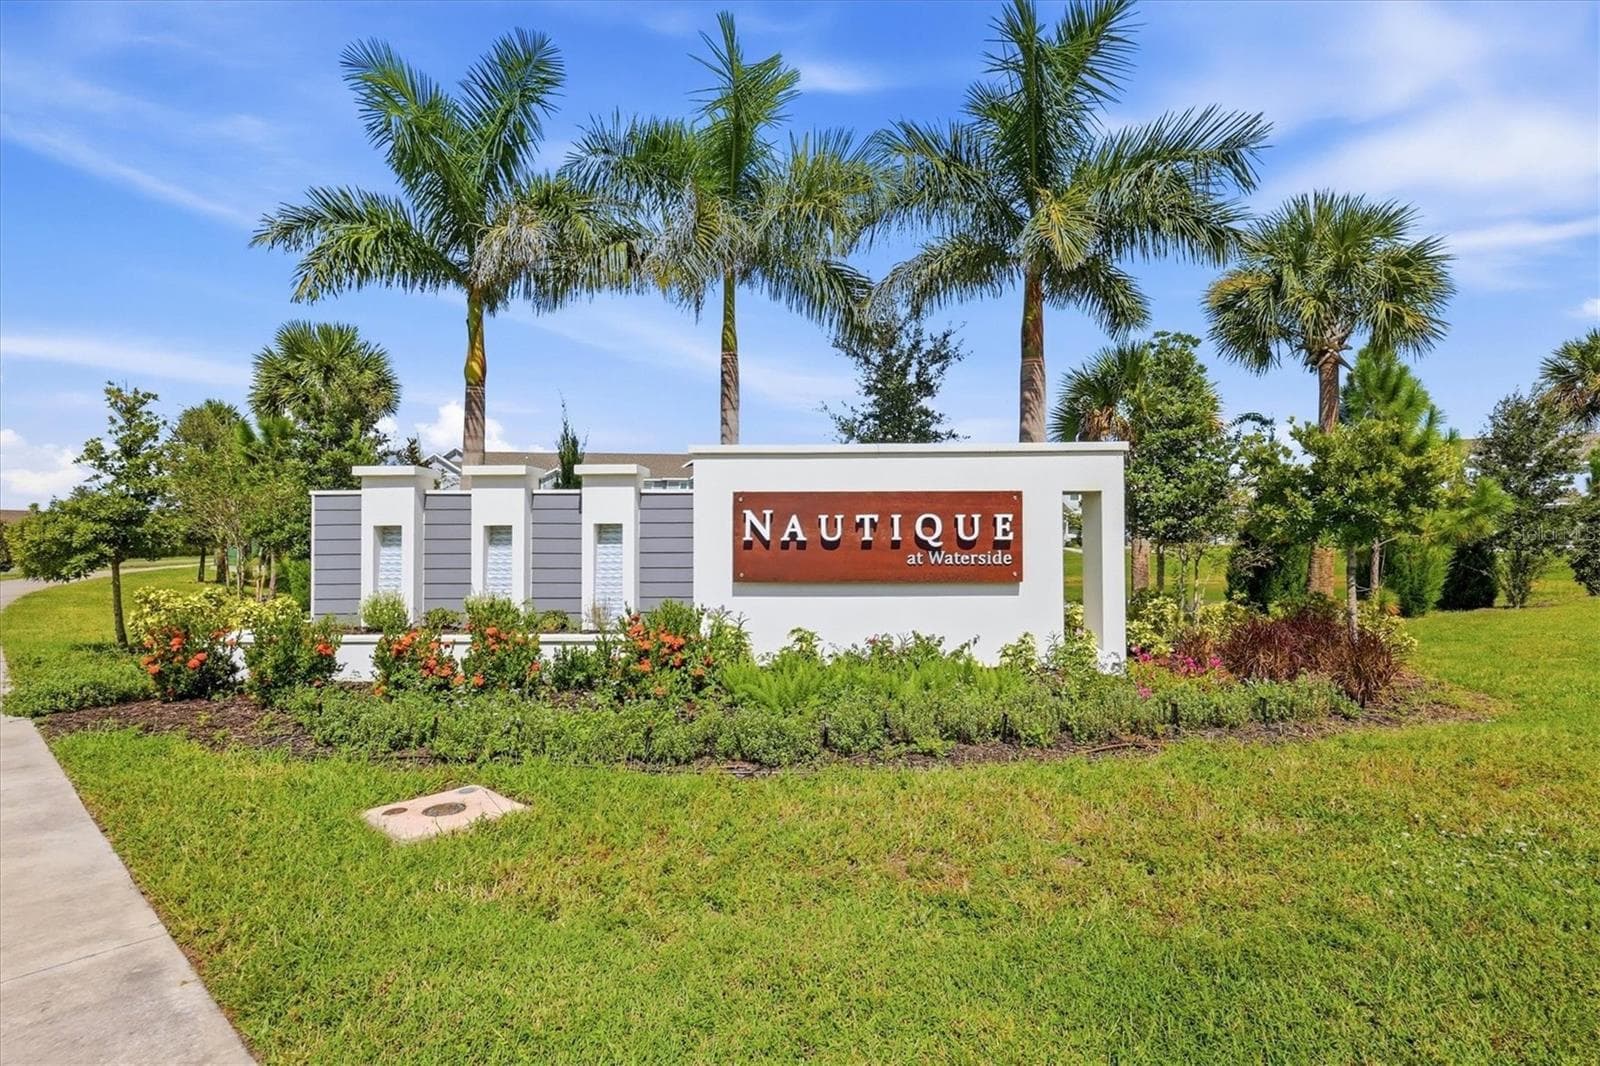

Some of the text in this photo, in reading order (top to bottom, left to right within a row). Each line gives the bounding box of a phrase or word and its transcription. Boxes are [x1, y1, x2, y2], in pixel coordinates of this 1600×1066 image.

[742, 509, 1014, 548] NAUTIQUE
[906, 549, 1013, 565] at Waterside
